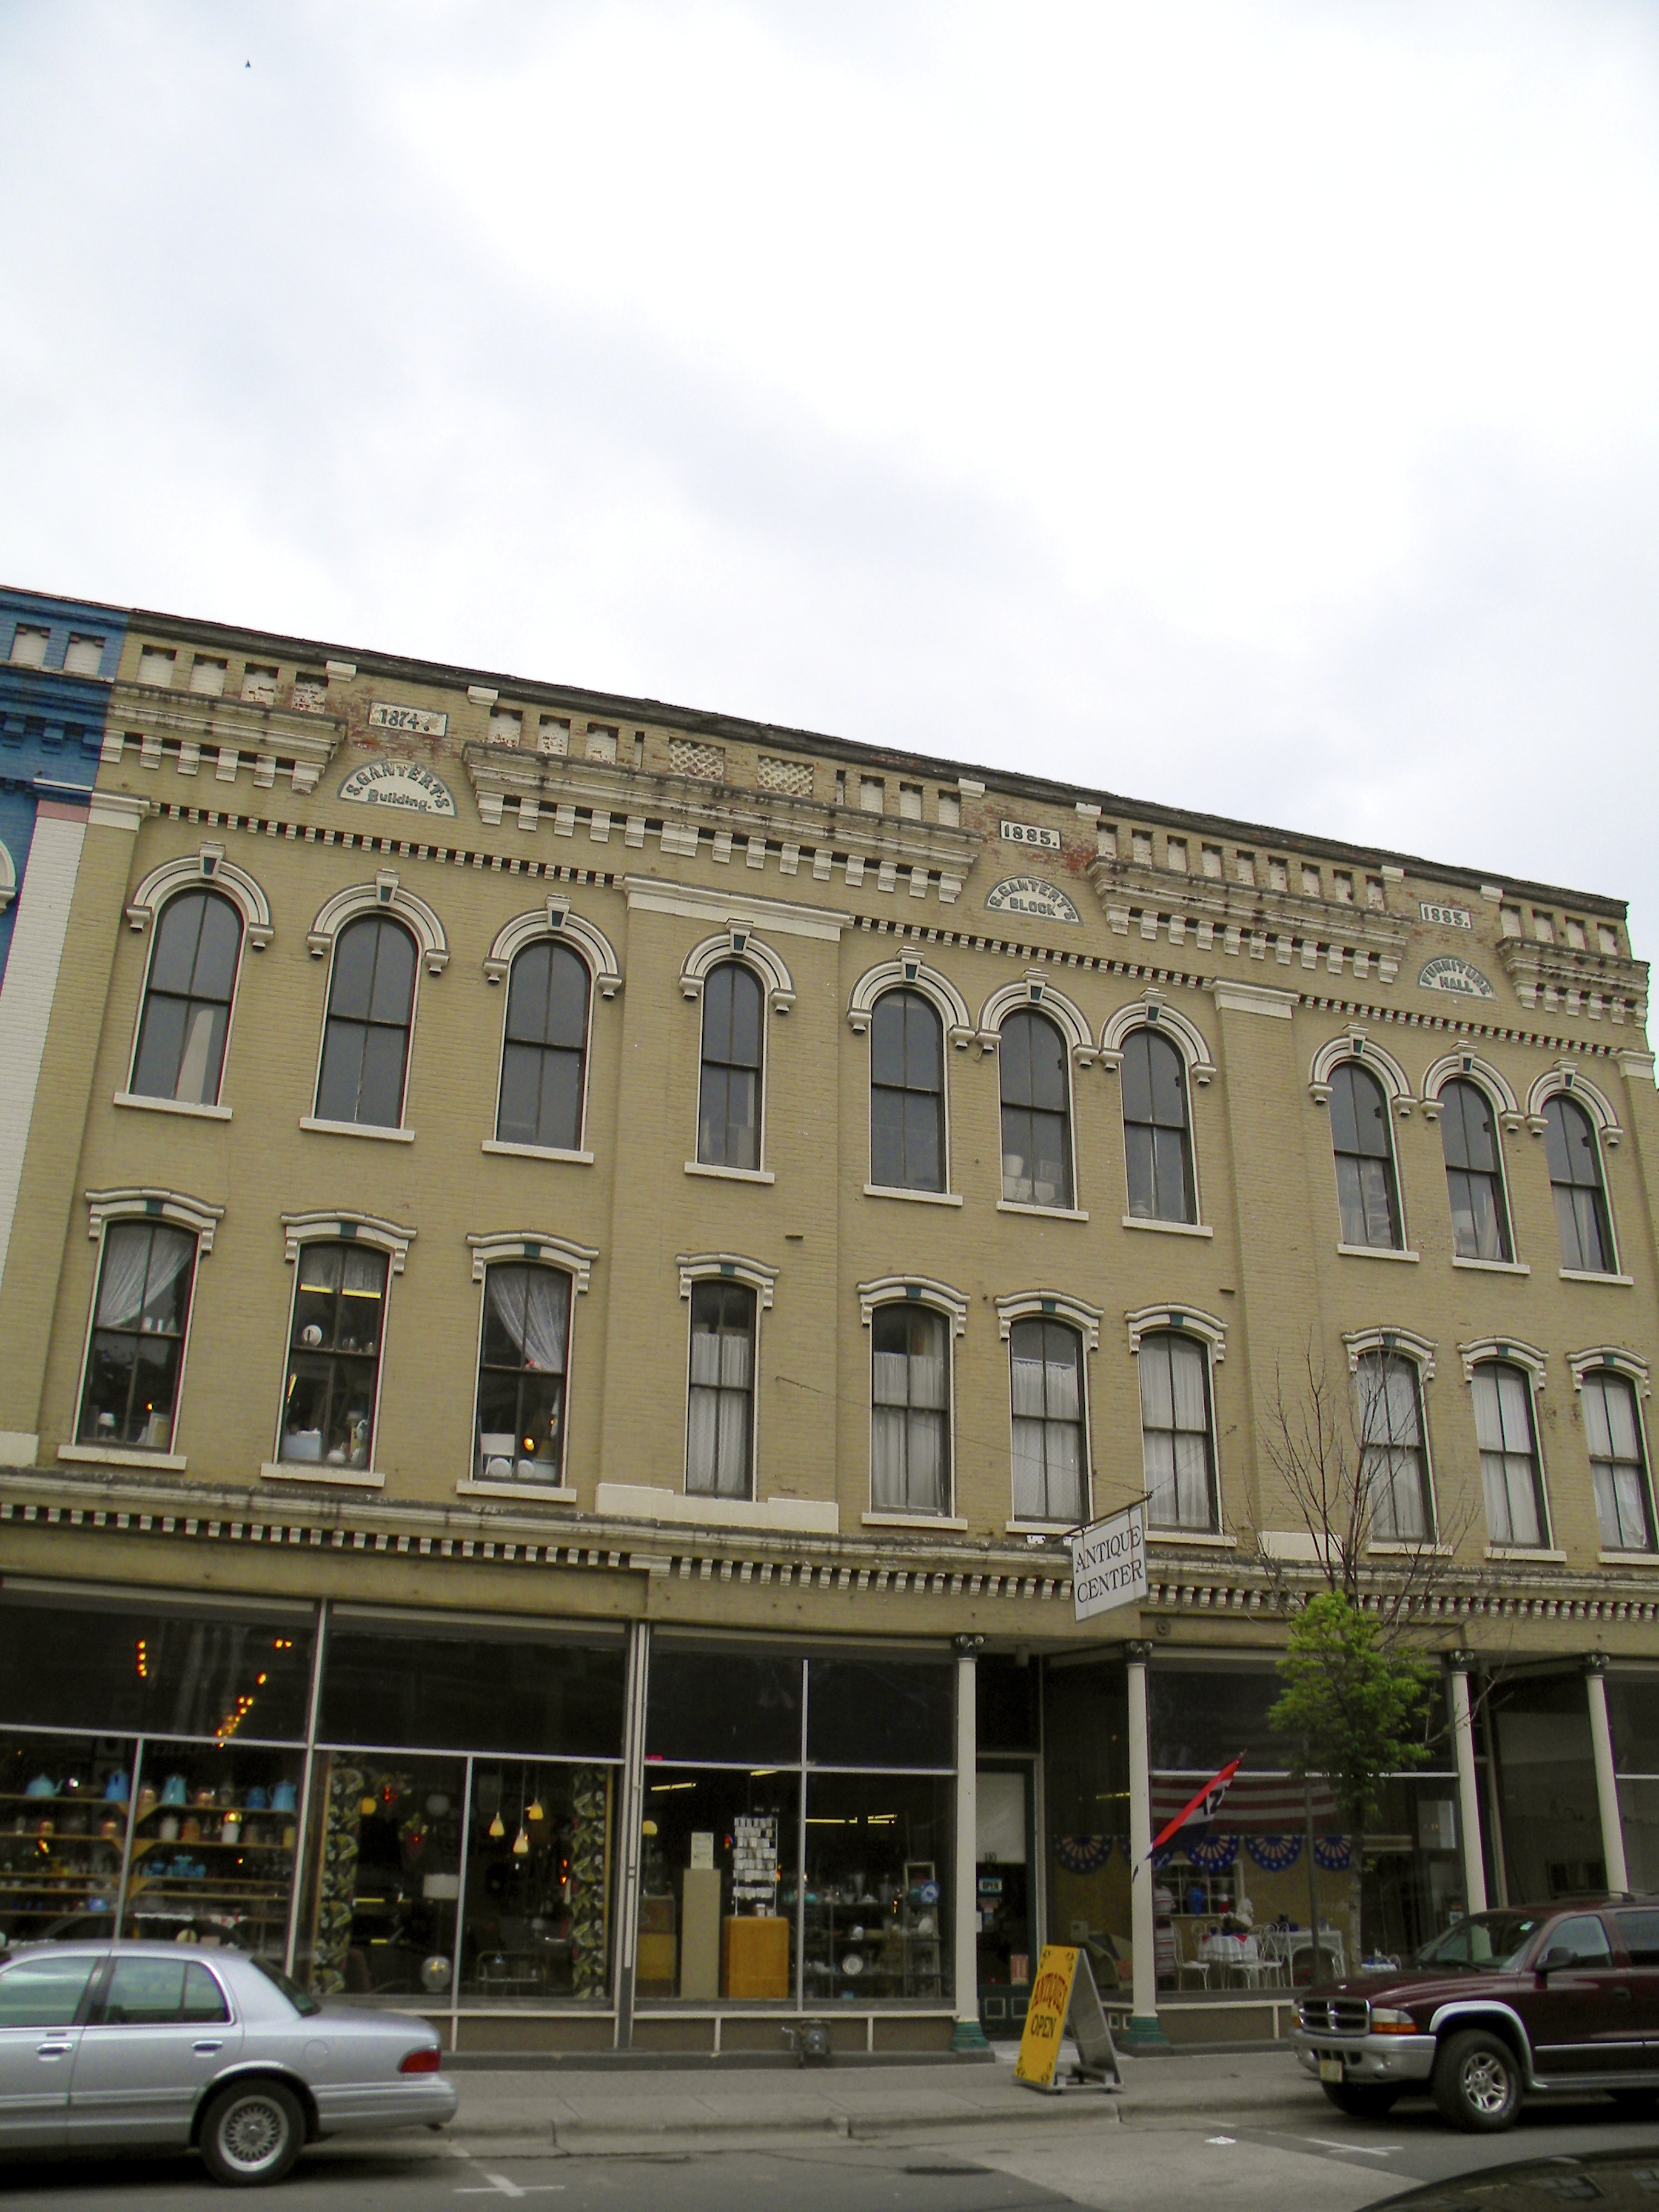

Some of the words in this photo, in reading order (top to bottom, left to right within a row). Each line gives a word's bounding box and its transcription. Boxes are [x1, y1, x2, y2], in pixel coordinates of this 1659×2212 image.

[367, 788, 432, 811] Building.
[1010, 897, 1056, 916] BLOCK
[1421, 959, 1491, 995] FURNITURE
[1439, 976, 1473, 993] HALL
[1075, 1525, 1141, 1574] ANTIQUE
[1078, 1559, 1144, 1603] CENTER
[1031, 2014, 1057, 2039] OPEN
